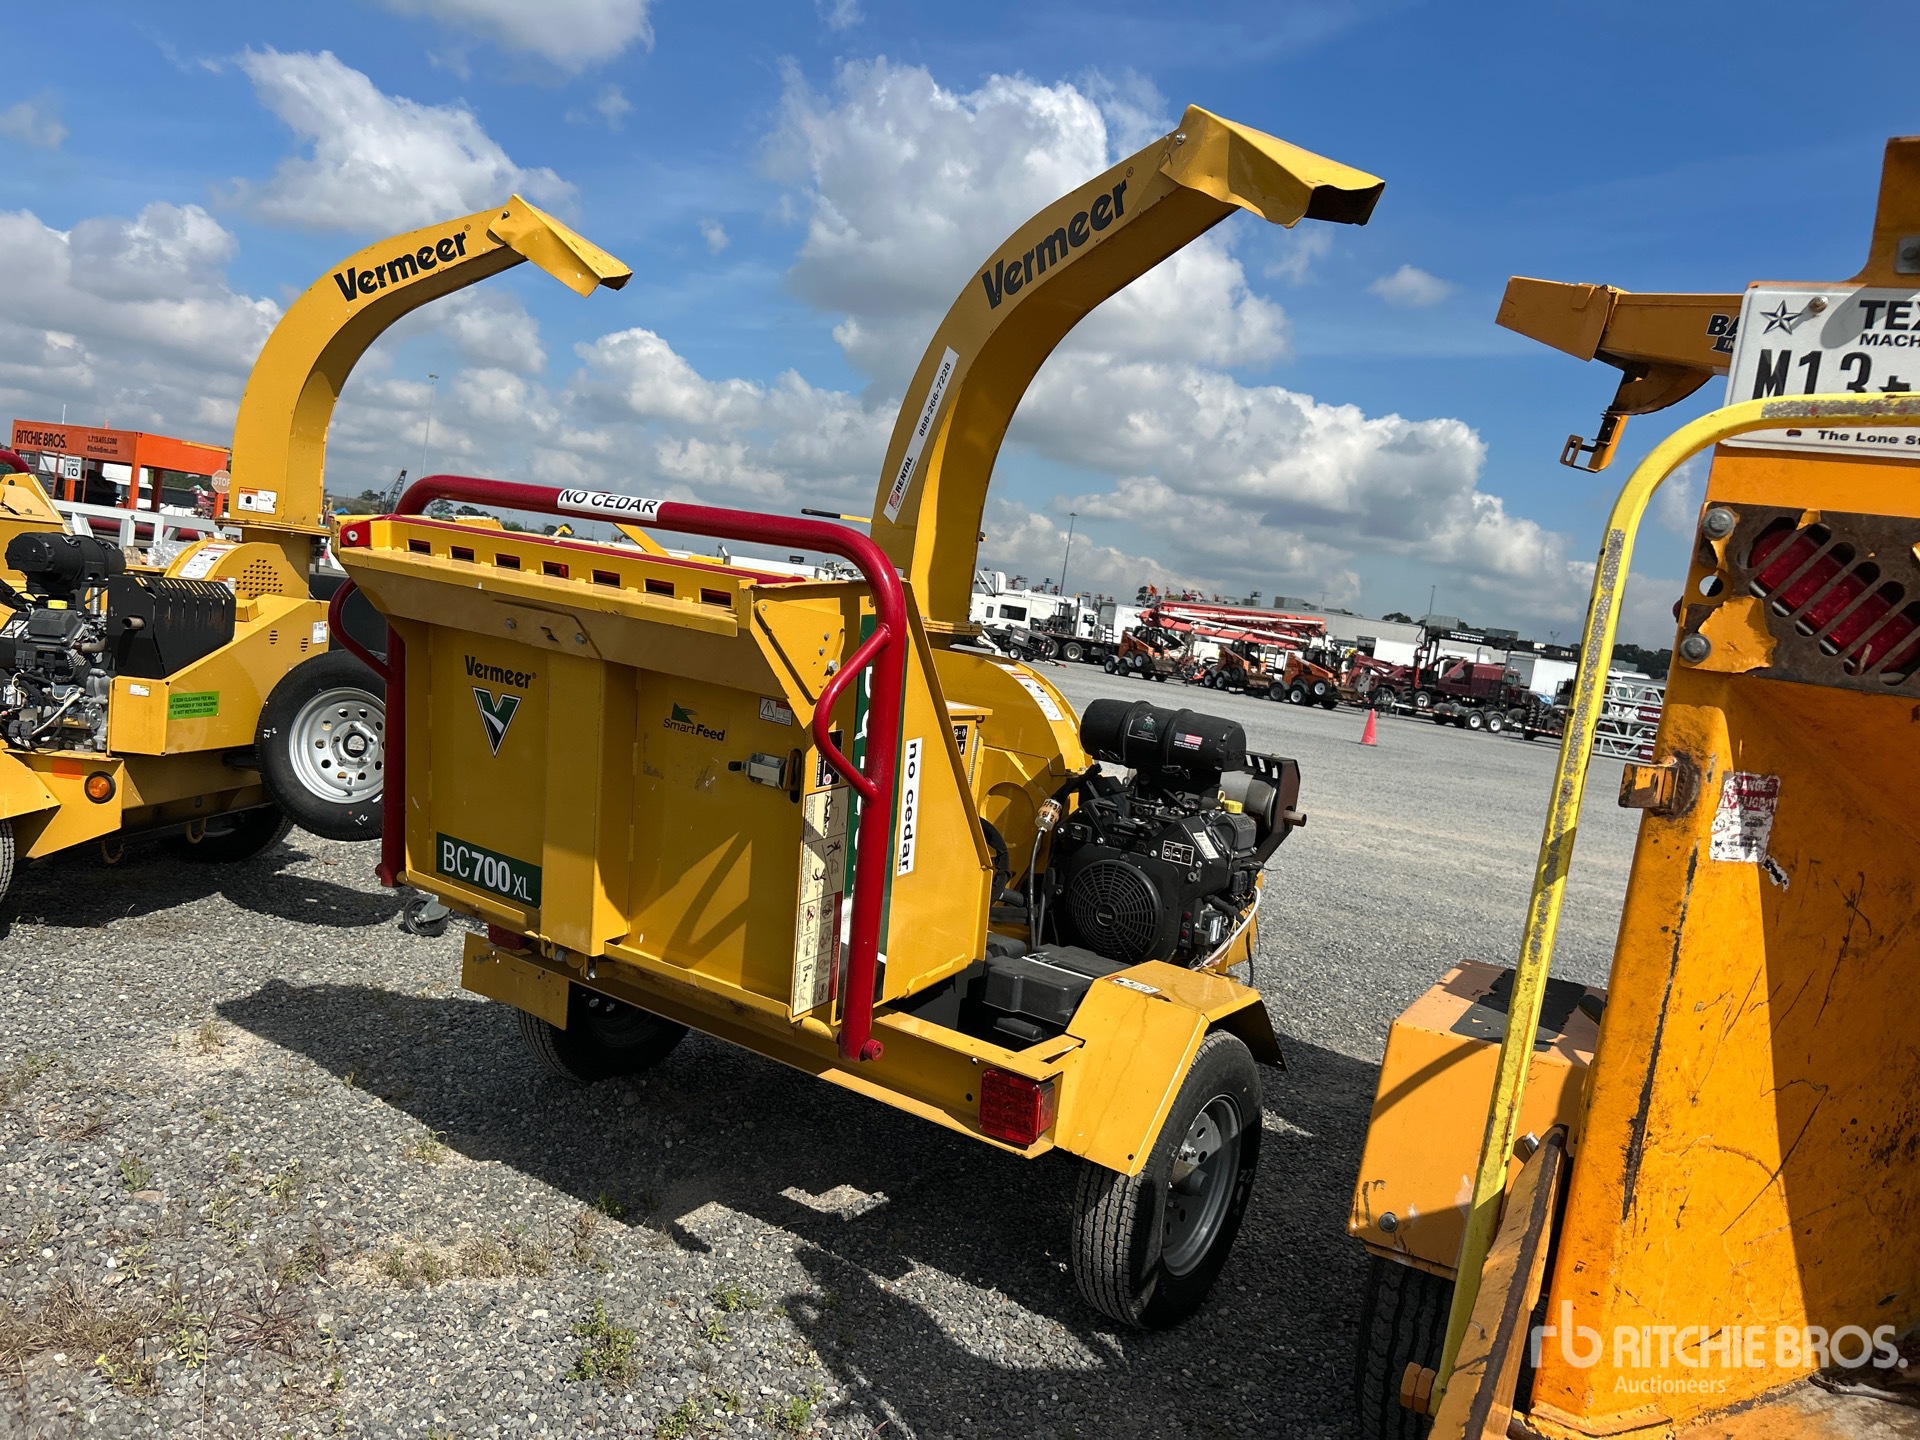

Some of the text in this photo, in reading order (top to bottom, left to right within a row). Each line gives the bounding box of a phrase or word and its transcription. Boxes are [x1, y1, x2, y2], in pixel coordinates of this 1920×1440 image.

[981, 179, 1129, 311] Vermeer
[333, 231, 467, 303] Vermeer
[15, 429, 42, 446] RITCHIE
[1818, 430, 1850, 442] The
[1856, 432, 1899, 445] Lone
[67, 467, 79, 477] 10
[895, 456, 914, 494] RENTAL
[559, 490, 659, 514] NO CEDAR
[464, 655, 532, 689] Vermeer
[901, 742, 918, 871] no cedar
